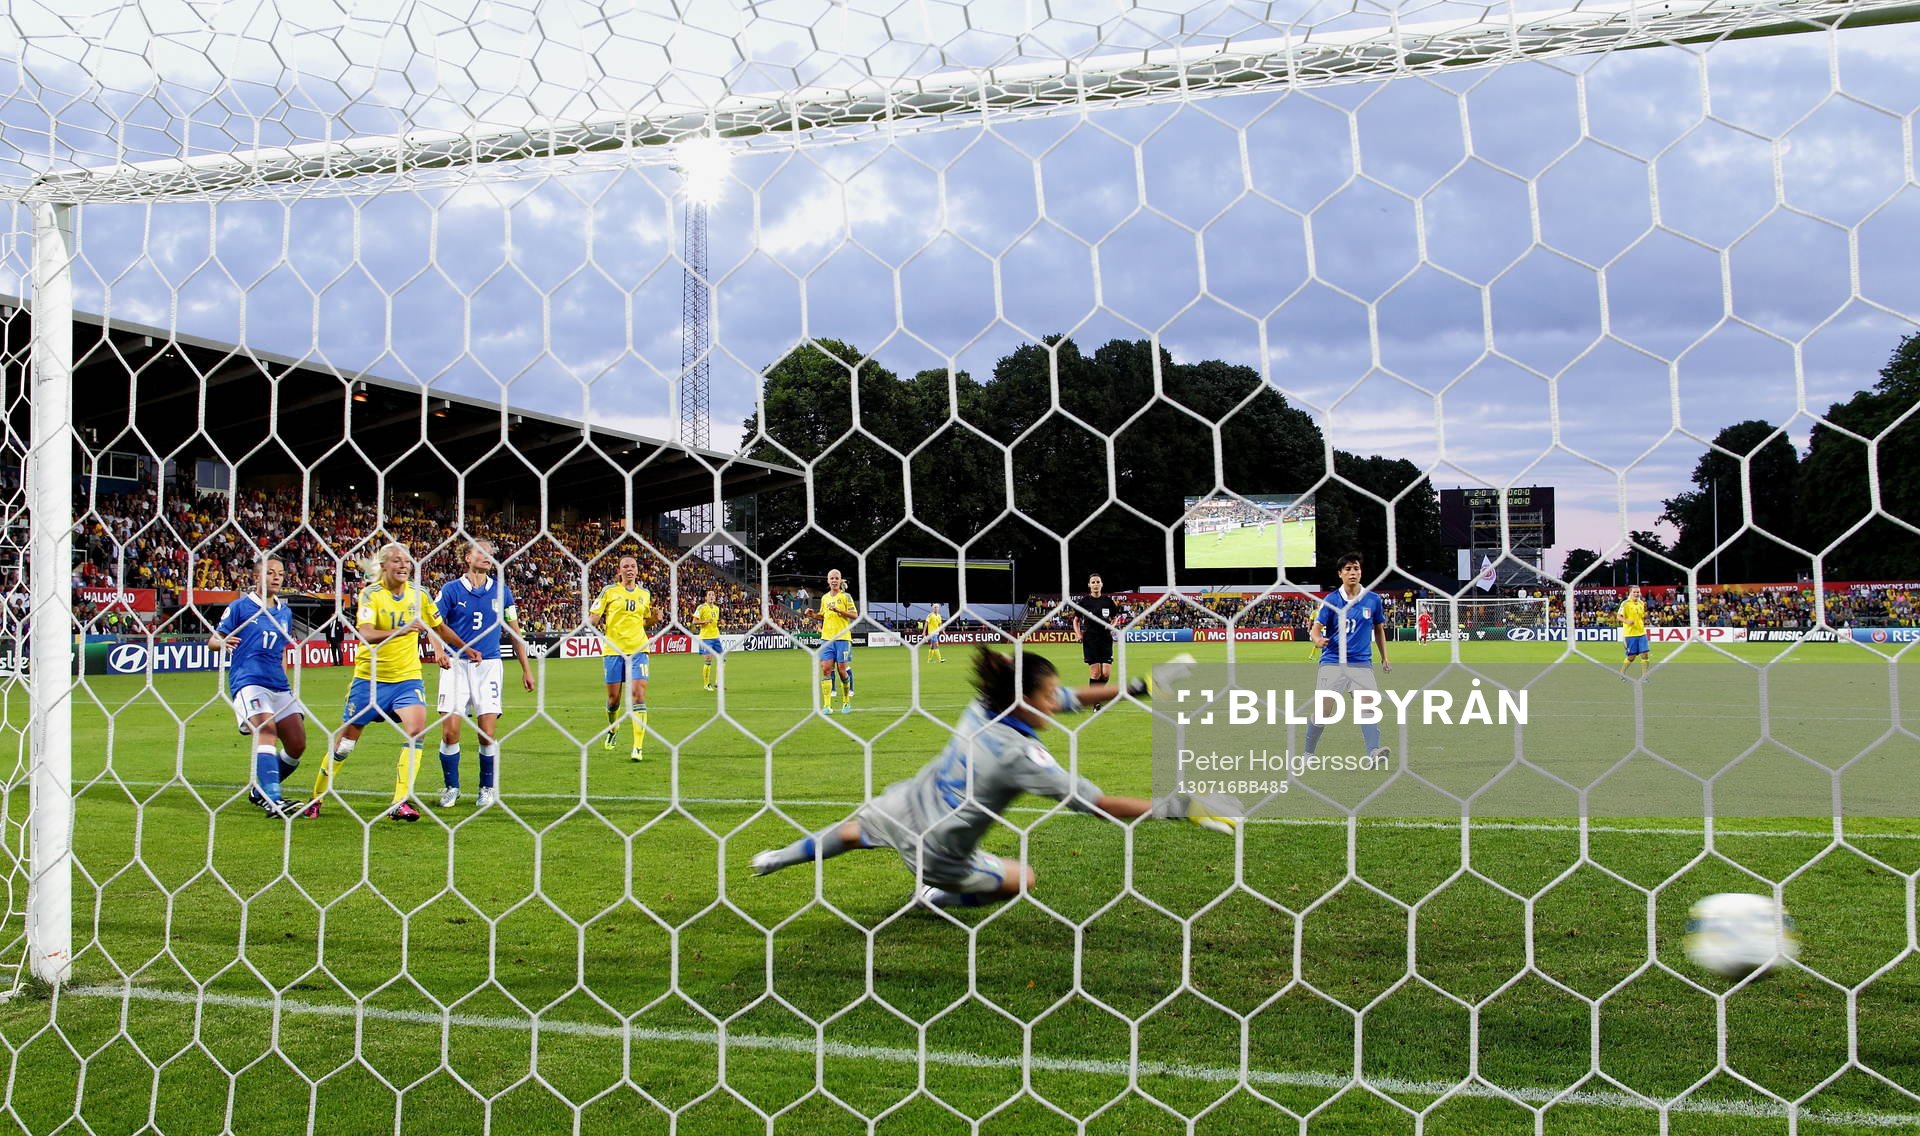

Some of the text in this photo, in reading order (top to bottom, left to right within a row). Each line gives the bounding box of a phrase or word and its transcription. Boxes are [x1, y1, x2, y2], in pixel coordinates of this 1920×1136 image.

[83, 591, 135, 603] HALMSAD
[625, 599, 636, 612] 18
[472, 612, 483, 630] 3
[262, 630, 278, 650] 17
[938, 633, 974, 643] OMEN'S
[975, 633, 1001, 642] EURO
[1126, 631, 1178, 642] RESPECT
[1208, 631, 1279, 640] Mconald's
[1749, 631, 1767, 641] HIT
[1768, 631, 1803, 641] MUSIC
[566, 638, 603, 657] SHA
[489, 681, 499, 698] 3
